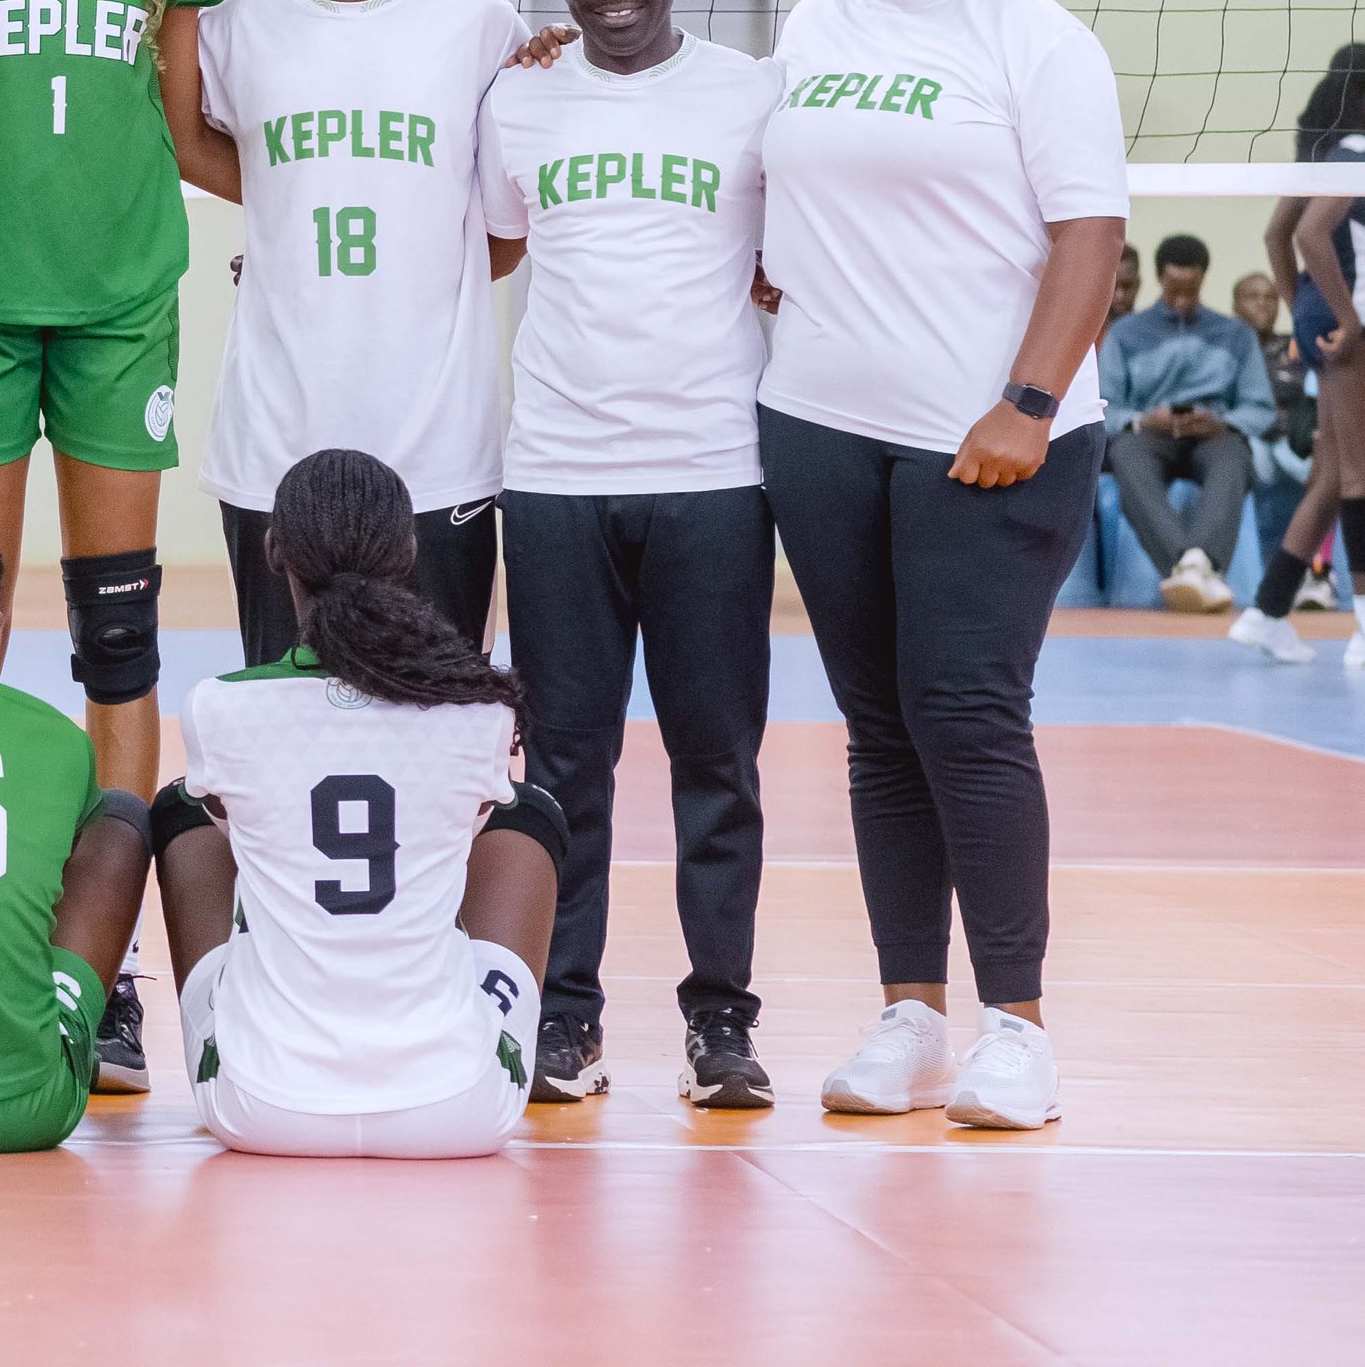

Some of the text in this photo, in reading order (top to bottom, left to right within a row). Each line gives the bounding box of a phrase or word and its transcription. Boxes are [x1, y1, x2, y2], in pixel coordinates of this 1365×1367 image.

[51, 76, 68, 135] 1
[777, 73, 943, 120] KEPLER
[263, 109, 437, 167] KEPLER
[538, 152, 722, 213] KEPLER
[312, 206, 377, 277] 18
[310, 774, 402, 916] 9
